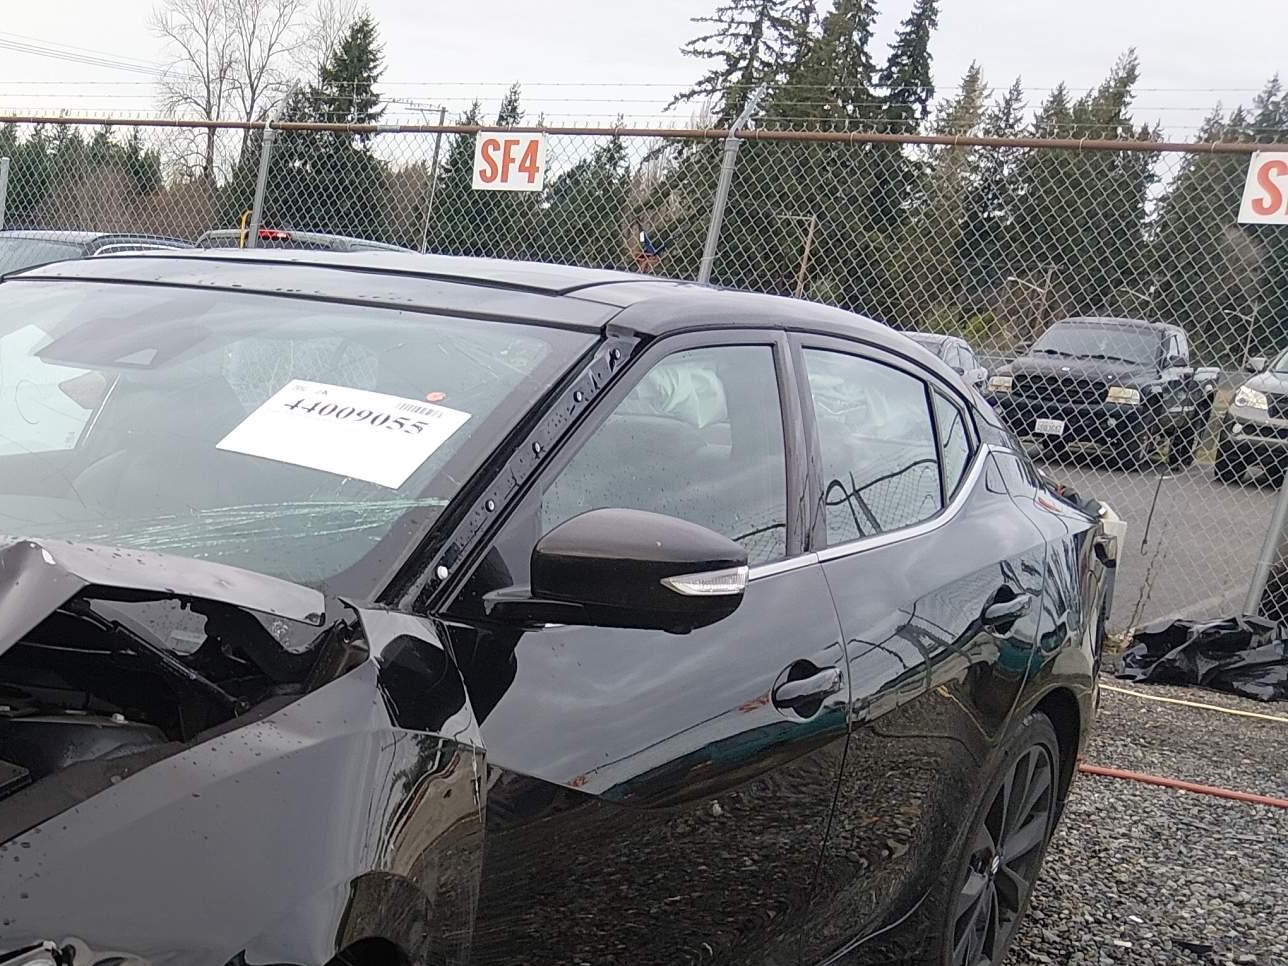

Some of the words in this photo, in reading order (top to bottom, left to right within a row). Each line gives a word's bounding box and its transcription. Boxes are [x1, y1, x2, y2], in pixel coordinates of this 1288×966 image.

[478, 138, 540, 184] SF4
[1251, 159, 1288, 216] S
[284, 398, 430, 434] 44009055
